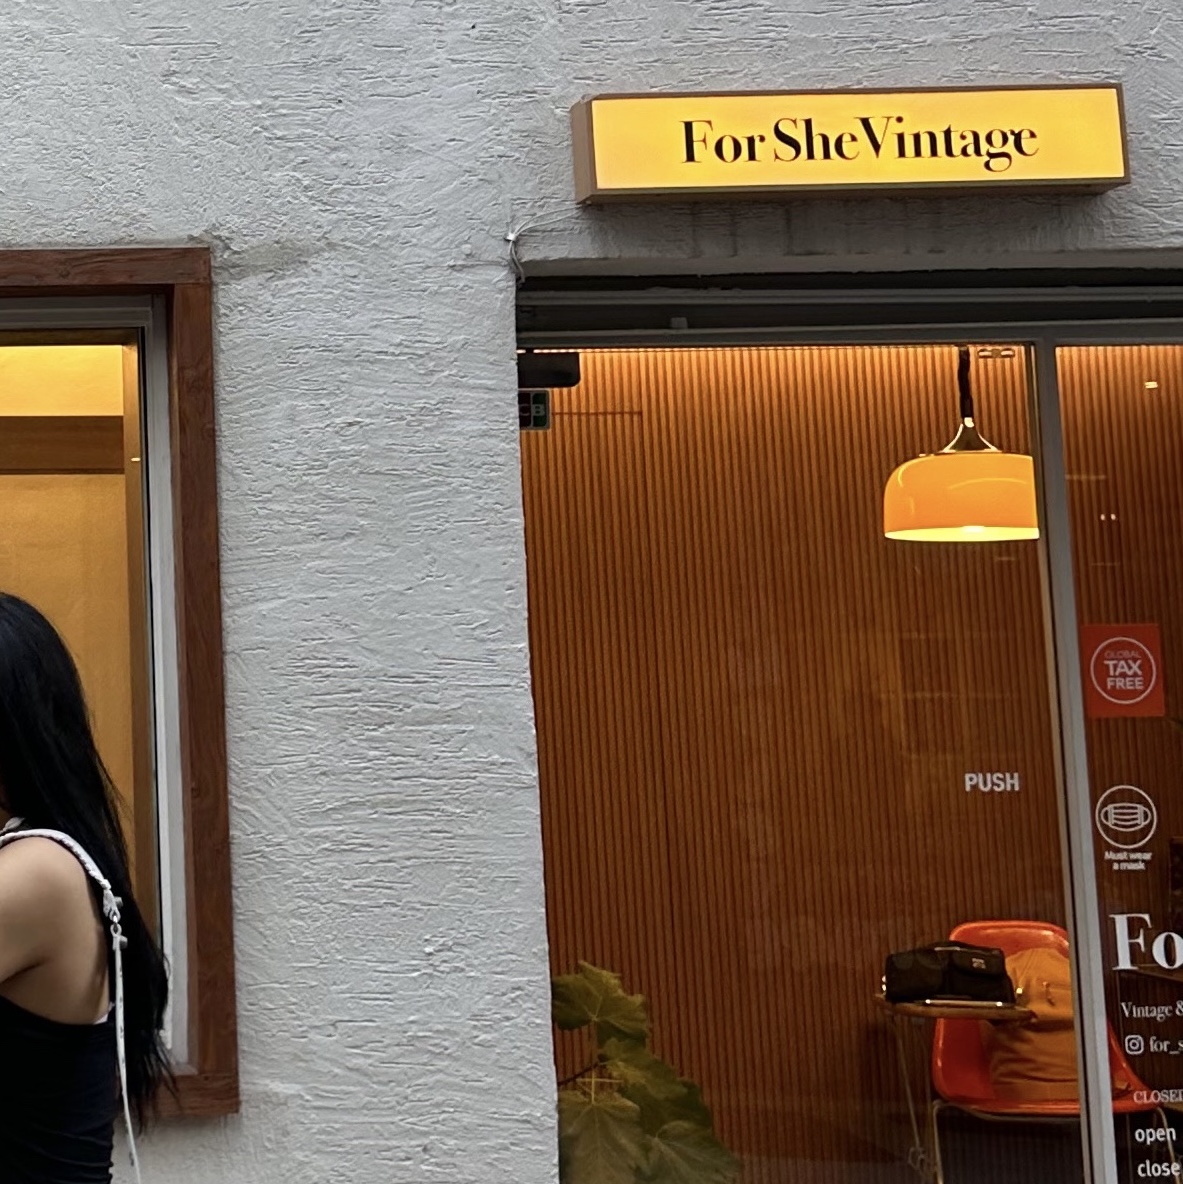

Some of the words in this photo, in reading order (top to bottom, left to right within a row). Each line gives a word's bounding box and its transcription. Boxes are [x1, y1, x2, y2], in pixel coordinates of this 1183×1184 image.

[680, 119, 766, 163] For
[854, 115, 1040, 173] Vintage
[1103, 660, 1143, 676] TAX
[1106, 677, 1144, 690] FREE
[964, 772, 1020, 792] PUSH
[1108, 913, 1183, 970] Fo
[1120, 1001, 1173, 1022] Vintage
[1134, 1127, 1177, 1145] open
[1137, 1159, 1181, 1177] close
